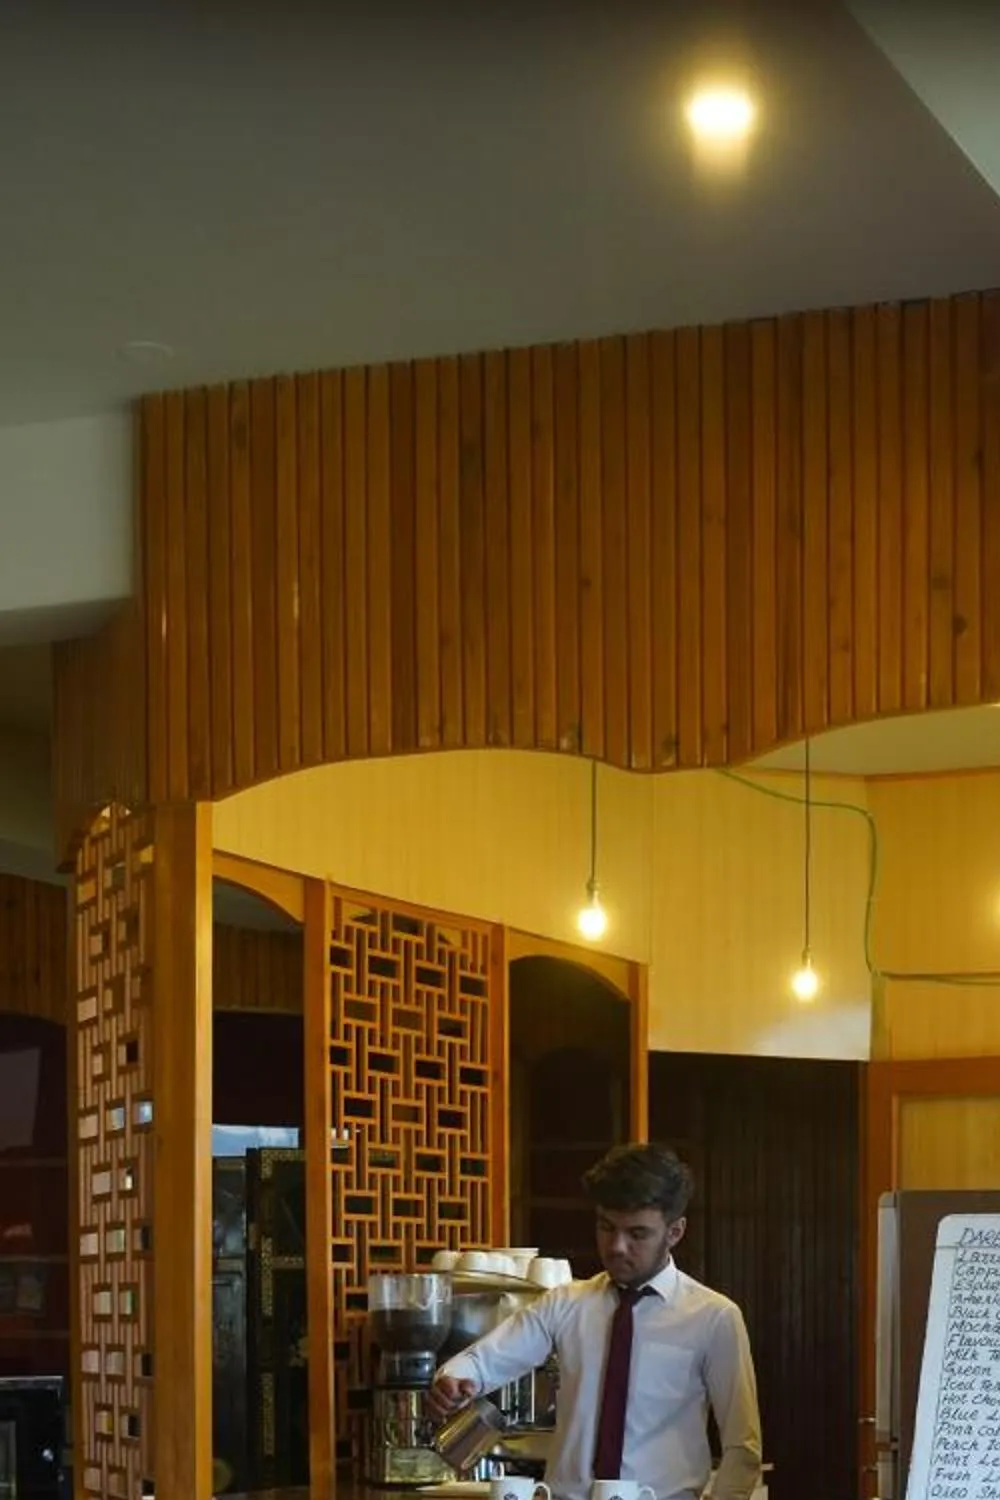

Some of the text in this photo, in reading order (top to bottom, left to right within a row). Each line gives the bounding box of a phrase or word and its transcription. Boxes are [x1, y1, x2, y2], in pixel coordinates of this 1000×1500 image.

[948, 1305, 990, 1319] Black
[944, 1348, 979, 1361] Milk
[944, 1361, 993, 1377] Green
[942, 1377, 976, 1391] Iced
[942, 1393, 968, 1405] Hot
[940, 1406, 979, 1421] Blue
[936, 1437, 979, 1452] Peach
[934, 1452, 970, 1467] Mint
[934, 1467, 971, 1481] Fresh
[931, 1484, 969, 1499] Oreo
